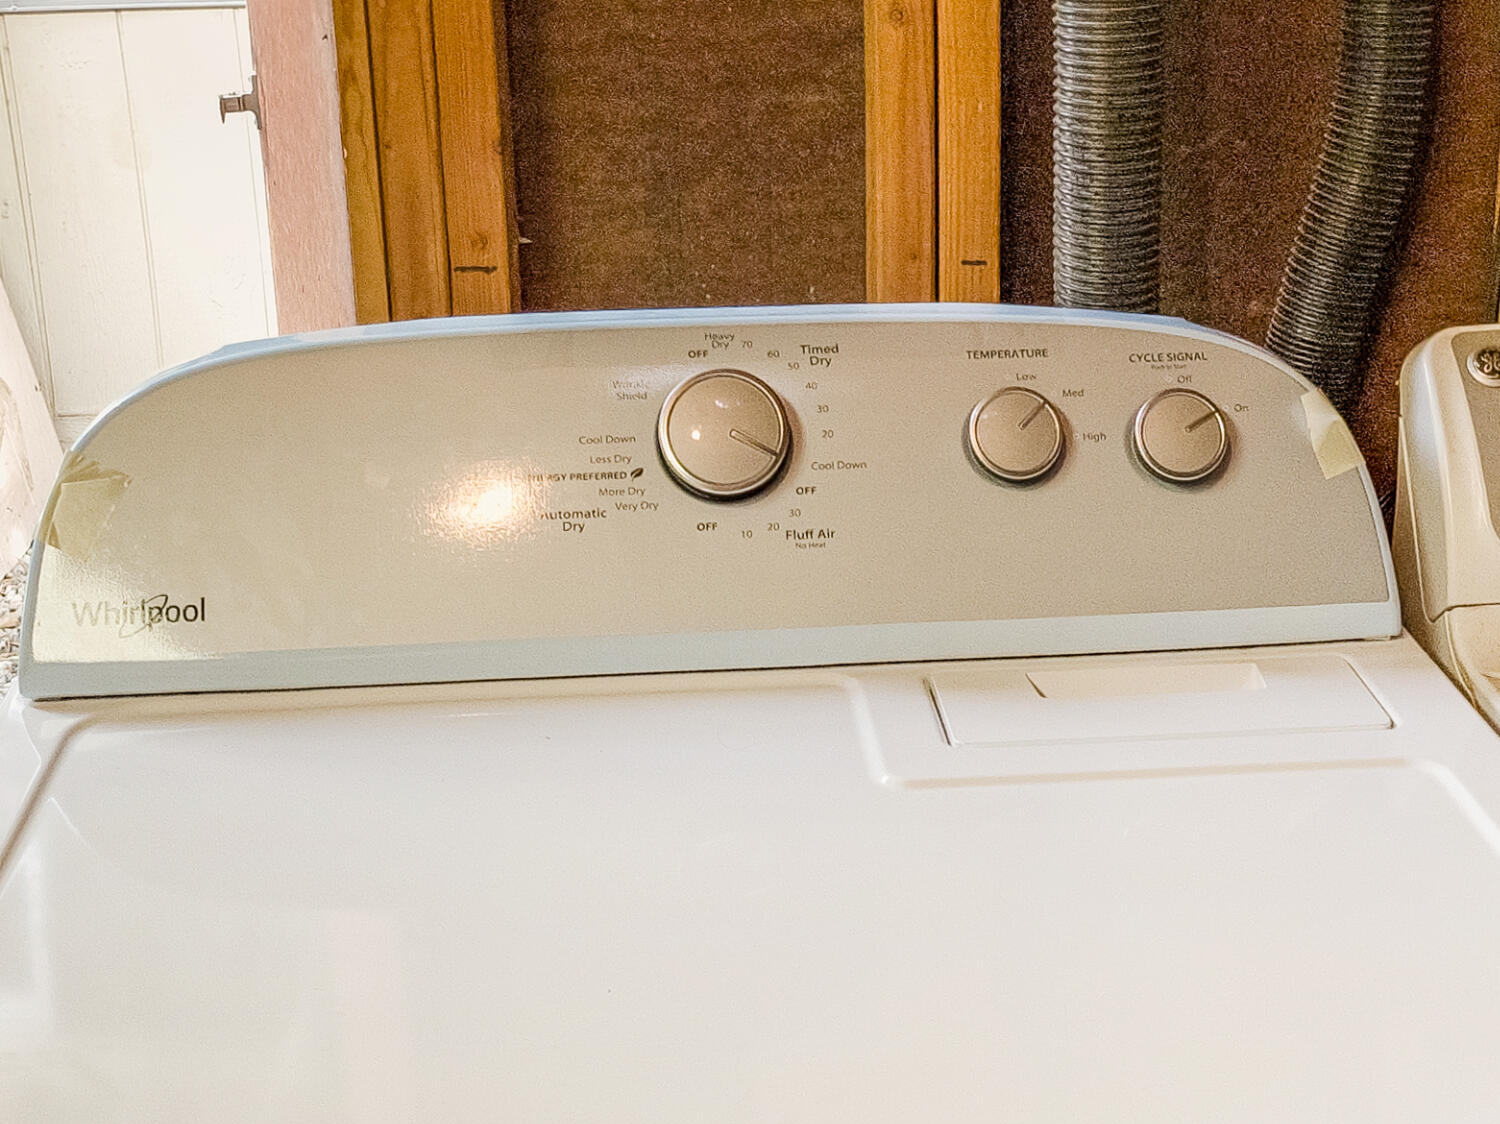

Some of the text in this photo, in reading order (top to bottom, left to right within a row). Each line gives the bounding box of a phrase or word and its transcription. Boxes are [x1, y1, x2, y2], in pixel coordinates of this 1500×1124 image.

[704, 331, 735, 344] Heavy
[712, 340, 730, 351] Dry
[742, 339, 753, 349] 70
[688, 349, 709, 359] OFF
[767, 349, 780, 359] 60
[800, 344, 840, 355] Timed
[966, 348, 1049, 360] TEMPERATURE
[809, 355, 832, 367] Dry
[1128, 351, 1208, 363] CYCLE SIGNAL
[787, 361, 800, 371] 50
[1015, 372, 1036, 382] Low
[805, 381, 818, 391] 40
[1062, 388, 1084, 398] Med
[816, 404, 829, 414] 30
[1234, 403, 1250, 413] On
[822, 429, 834, 439] 20
[1083, 431, 1107, 443] High
[578, 434, 637, 445] Cool Down
[589, 454, 633, 465] Less Dry
[811, 460, 867, 471] Cool Down
[569, 471, 628, 481] PREFERRED
[598, 487, 646, 497] More Dry
[795, 486, 817, 496] OFF
[615, 501, 660, 513] Very Dry
[788, 508, 801, 518] 30
[562, 521, 586, 534] Dry
[696, 522, 718, 532] OFF
[767, 523, 780, 532] 20
[742, 529, 753, 539] 10
[785, 528, 836, 541] Fluff Air
[72, 596, 205, 633] Whirlpool
